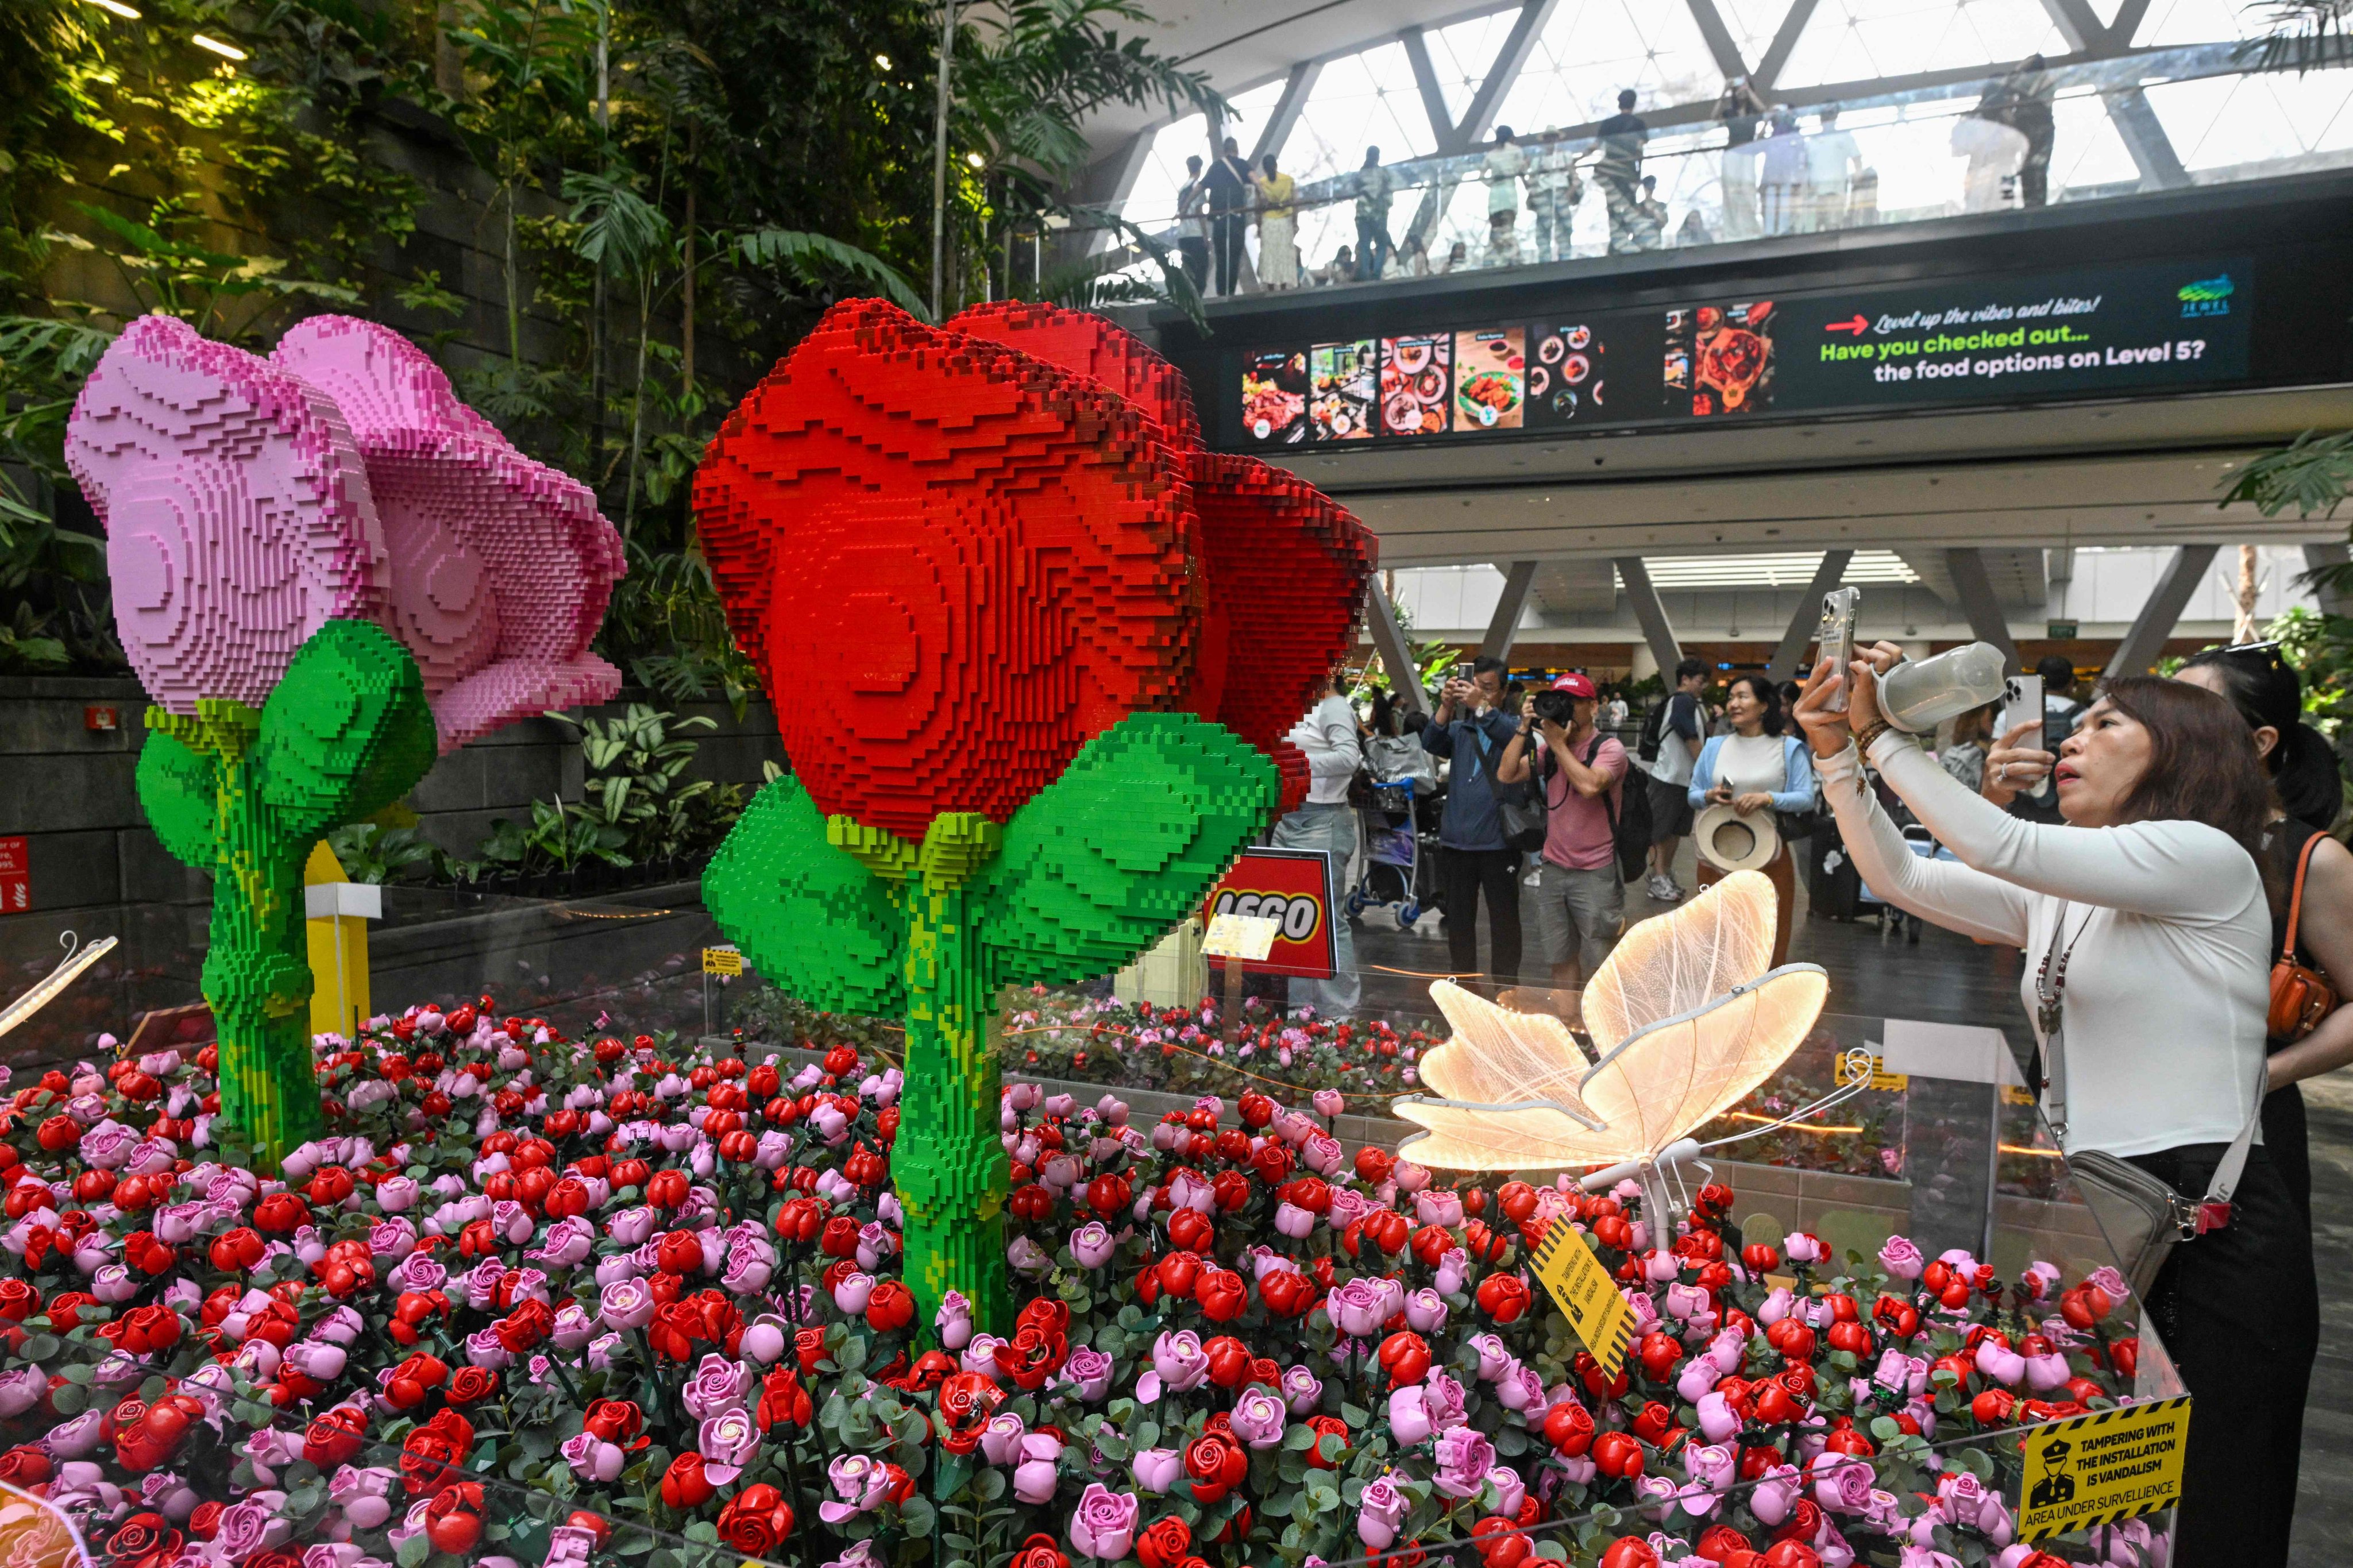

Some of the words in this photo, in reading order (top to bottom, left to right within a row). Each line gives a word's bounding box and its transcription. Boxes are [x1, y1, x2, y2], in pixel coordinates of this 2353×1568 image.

[1873, 310, 1922, 334] Level
[1918, 312, 1942, 330] up
[1943, 306, 1970, 325] the
[1970, 304, 2013, 322] vibes
[2016, 298, 2054, 318] and
[2051, 295, 2102, 315] bites!
[1820, 343, 1874, 361] Have
[1877, 340, 1919, 361] you
[1923, 326, 2026, 354] checked
[2029, 325, 2090, 345] out...
[1873, 363, 1912, 382] the
[1915, 357, 1970, 380] food
[1973, 352, 2065, 379] options
[2068, 351, 2100, 368] on
[2105, 341, 2171, 366] Level
[2175, 339, 2207, 361] 5?
[1562, 1257, 1577, 1282] TAMPERING
[1573, 1247, 1582, 1262] WITH
[1570, 1286, 1578, 1299] THE
[1574, 1261, 1591, 1289] INSTALLATION
[1587, 1257, 1593, 1266] IS
[1583, 1278, 1598, 1304] VANDALISM
[1589, 1338, 1597, 1352] AREA
[1594, 1326, 1602, 1342] UNDER
[1598, 1311, 1608, 1330] SECURITY
[2077, 1456, 2098, 1471] THE
[2100, 1439, 2175, 1466] INSTALLATION
[2081, 1428, 2144, 1452] TAMPERING
[2146, 1422, 2175, 1438] WITH
[2086, 1474, 2097, 1486] IS
[2099, 1459, 2162, 1484] VANDALISM
[2024, 1512, 2055, 1527] AREA
[2057, 1501, 2095, 1519] UNDER
[2097, 1480, 2174, 1509] SURVELLIENCE
